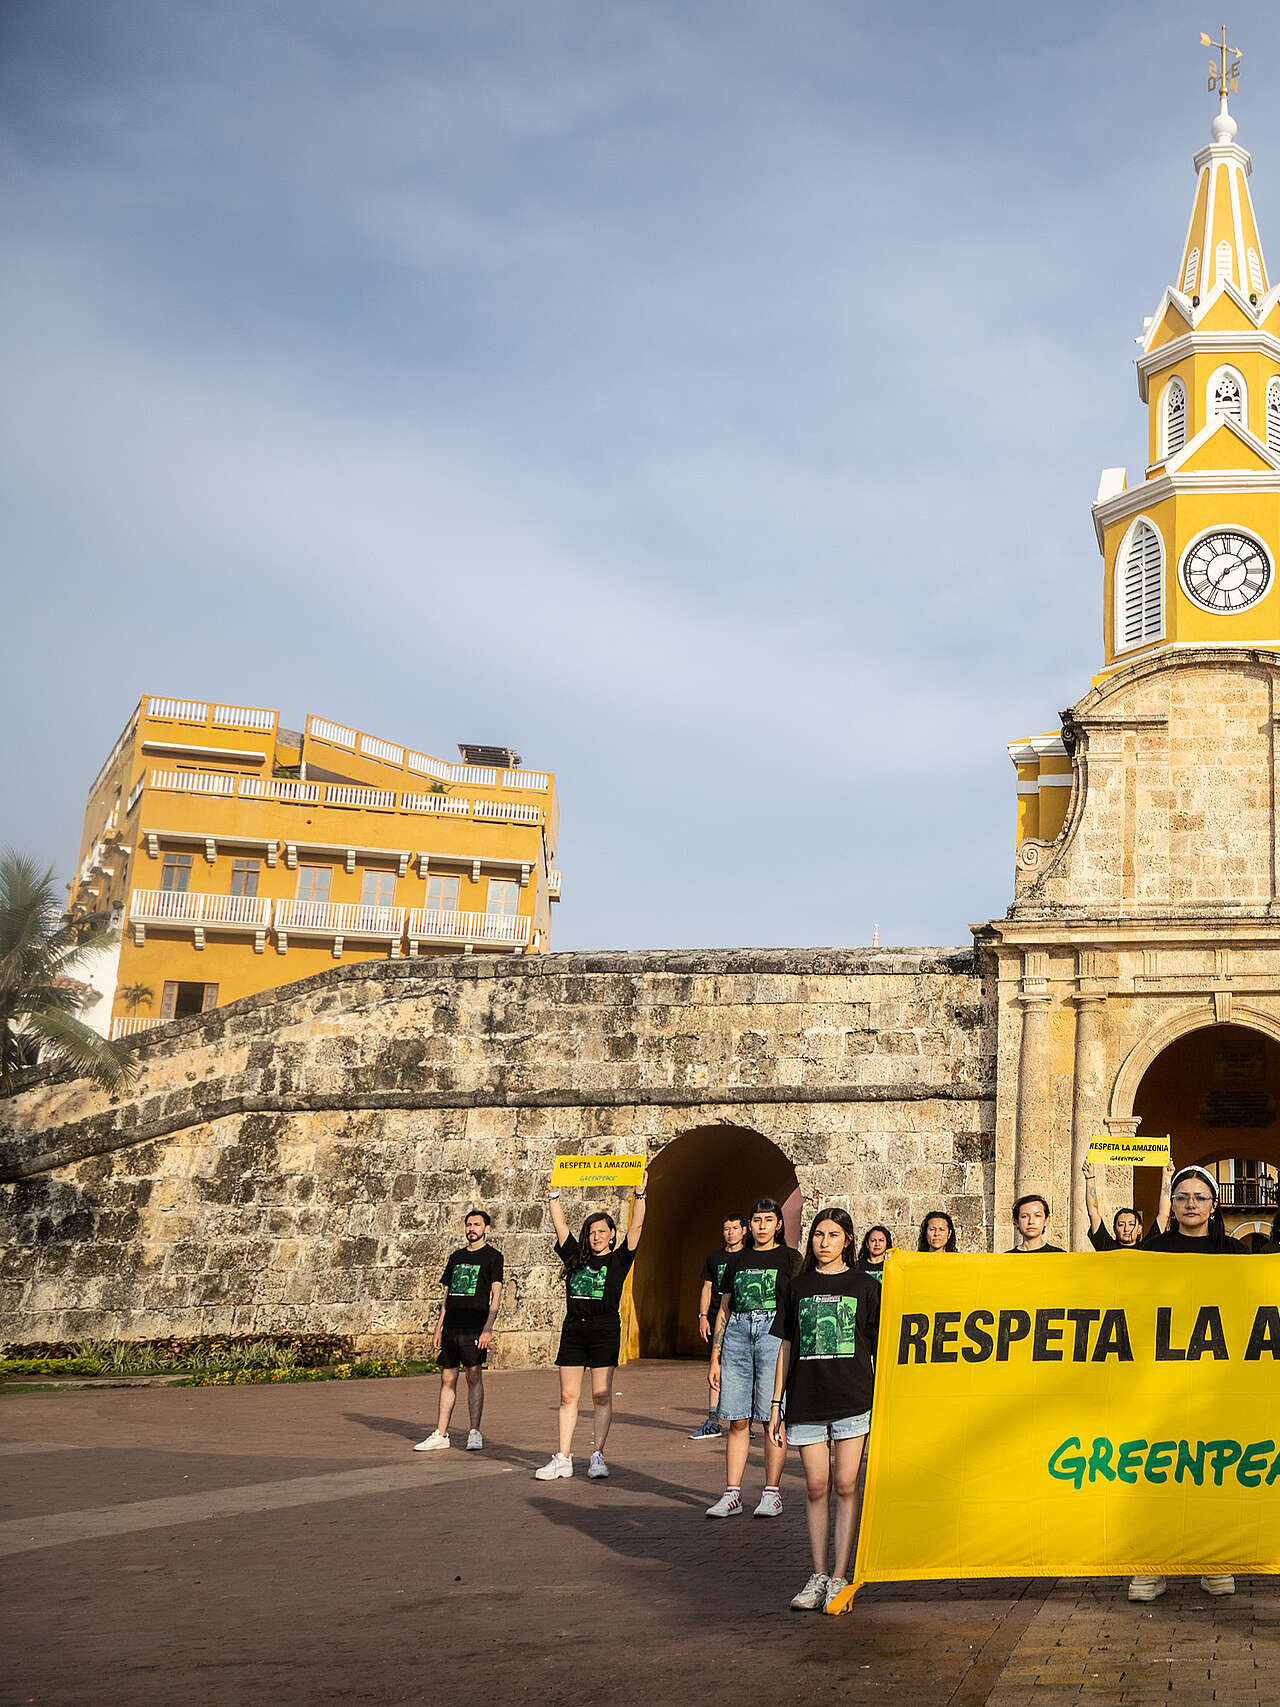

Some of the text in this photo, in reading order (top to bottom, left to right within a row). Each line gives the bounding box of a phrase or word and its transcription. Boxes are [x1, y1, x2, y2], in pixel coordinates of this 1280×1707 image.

[1089, 1142, 1120, 1151] RESPETA
[1132, 1144, 1169, 1152] AMAZONIA
[559, 1161, 591, 1169] RESPETA
[593, 1161, 603, 1169] LA
[897, 1308, 1134, 1365] RESPETA
[1154, 1306, 1230, 1362] LA
